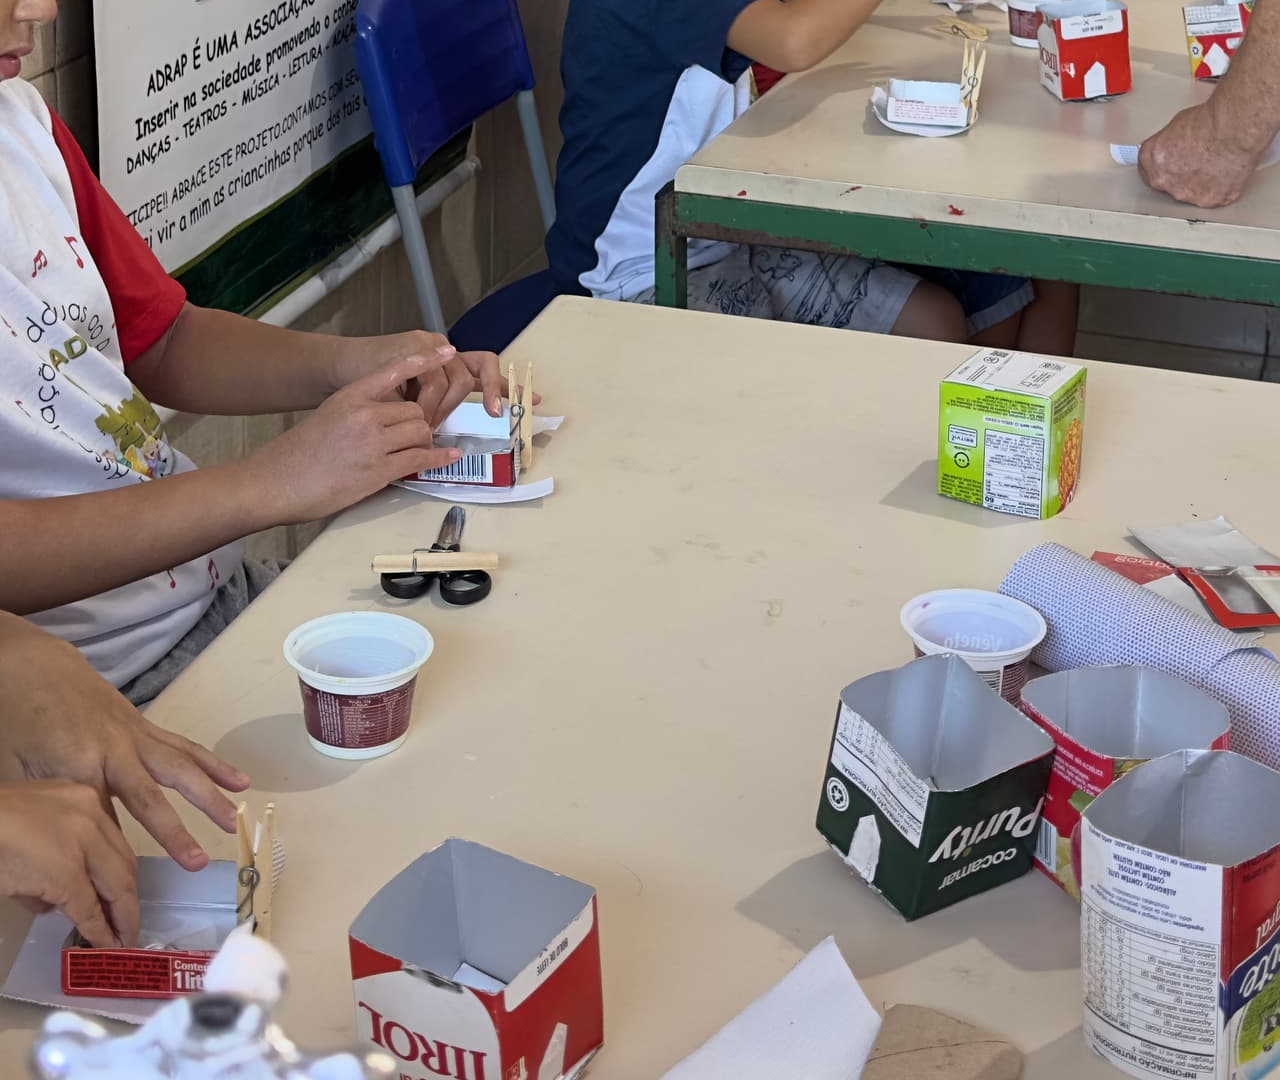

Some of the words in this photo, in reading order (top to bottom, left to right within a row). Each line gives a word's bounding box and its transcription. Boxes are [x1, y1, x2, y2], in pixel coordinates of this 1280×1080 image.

[135, 99, 179, 141] Inserir
[183, 91, 197, 113] na
[201, 53, 262, 101] sociedade
[266, 17, 321, 74] promovendo
[324, 16, 331, 30] o
[147, 53, 188, 97] ADRAP
[192, 36, 201, 70] É
[206, 29, 239, 62] UMA
[126, 135, 172, 175] DANÇAS
[182, 100, 228, 138] TEATROS
[241, 73, 280, 107] MÚSICA
[288, 43, 323, 78] LEITURA
[171, 164, 207, 205] ABRACE
[208, 148, 233, 179] ESTE
[328, 78, 344, 102] COM
[157, 219, 176, 244] vir
[179, 215, 187, 232] a
[190, 198, 211, 226] mim
[213, 185, 225, 208] as
[228, 145, 292, 198] criancinhas
[293, 122, 324, 157] porque
[326, 107, 343, 133] dos
[342, 94, 360, 119] tais
[841, 766, 877, 798] NUTRICIONAL
[876, 796, 909, 836] INFORMAÇÃO
[928, 796, 1045, 863] Purity
[938, 848, 1017, 890] cocamar
[1120, 874, 1143, 887] CONTÉM
[1134, 861, 1157, 874] CONTÉM
[1142, 869, 1165, 885] CONTÉM
[1158, 867, 1171, 878] NÃO
[1144, 882, 1177, 897] ALÉRGICOS:
[1092, 1030, 1136, 1062] NUTRICIONAL
[1139, 1059, 1197, 1080] INFORMAÇÃO
